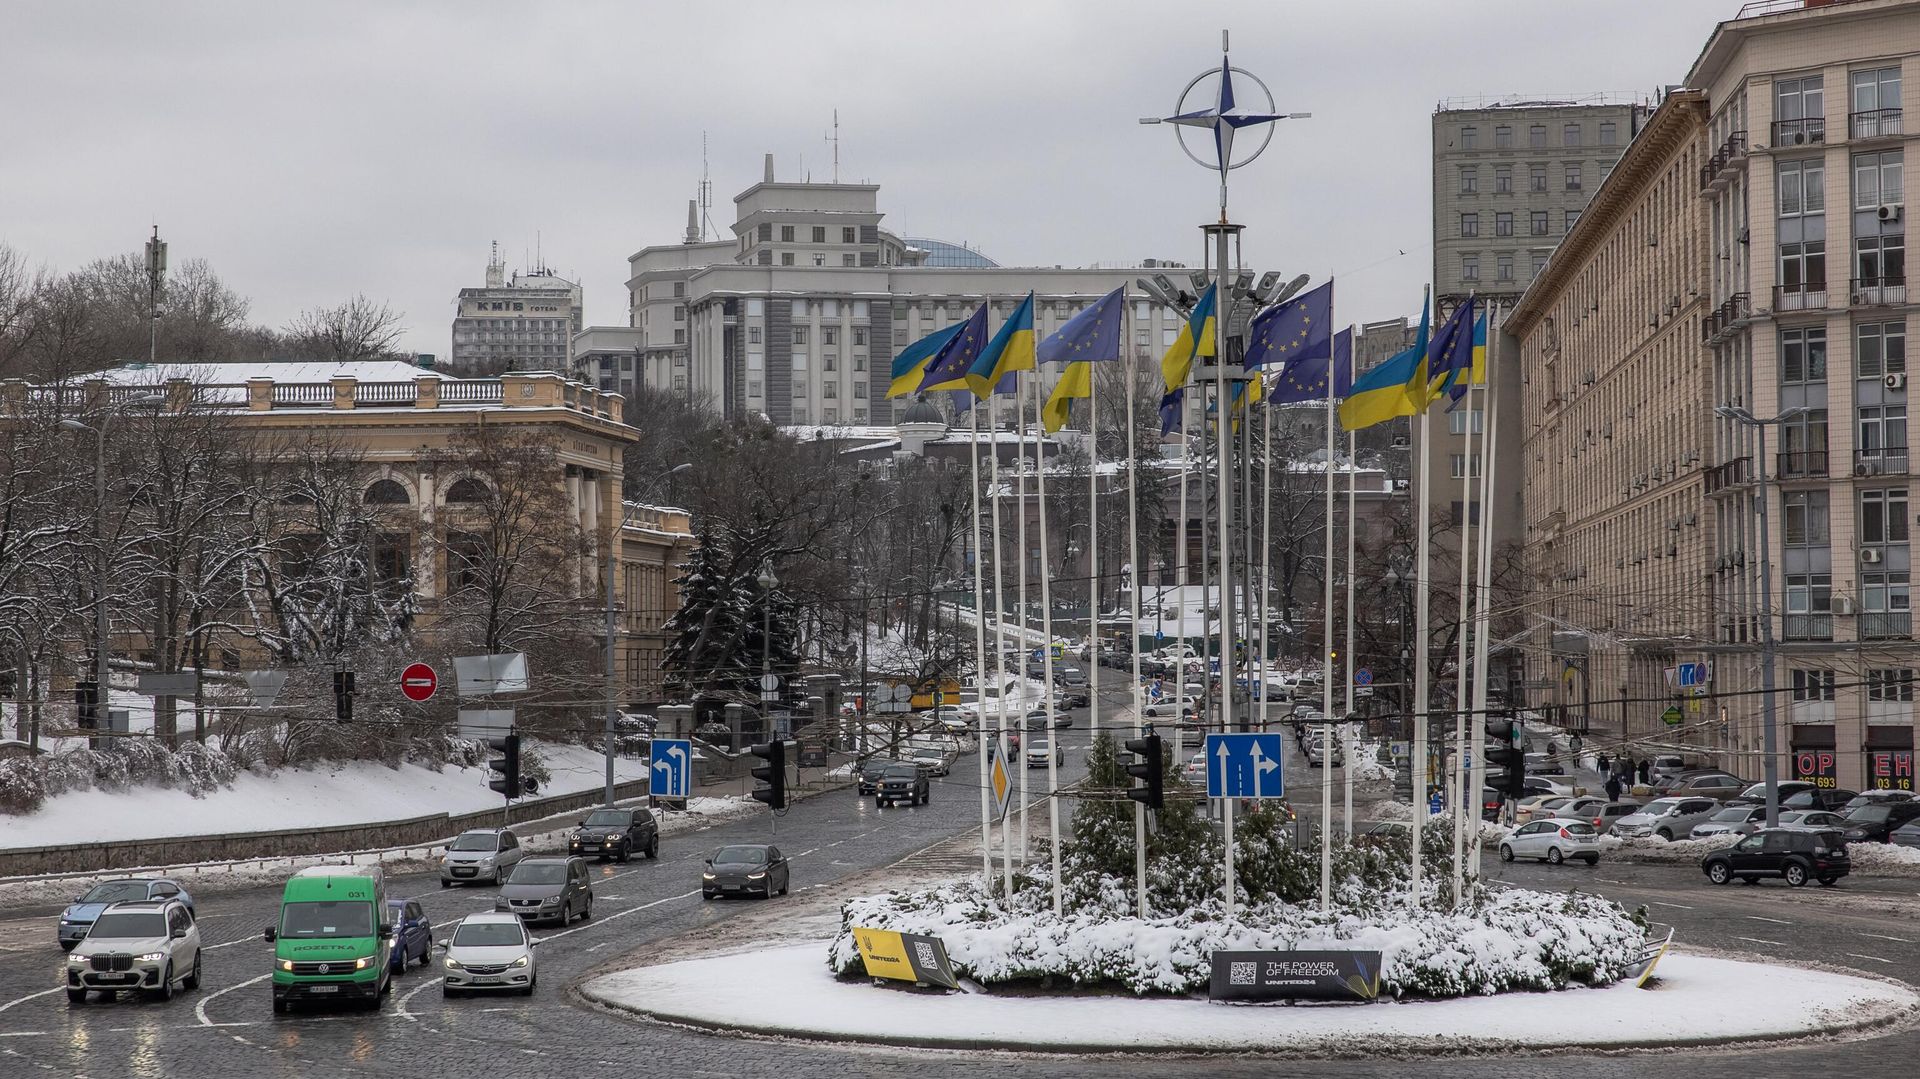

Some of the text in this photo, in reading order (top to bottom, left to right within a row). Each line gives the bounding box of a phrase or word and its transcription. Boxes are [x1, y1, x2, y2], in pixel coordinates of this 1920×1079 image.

[1817, 777, 1835, 788] 693
[1877, 778, 1890, 789] 03
[1898, 779, 1910, 789] 16
